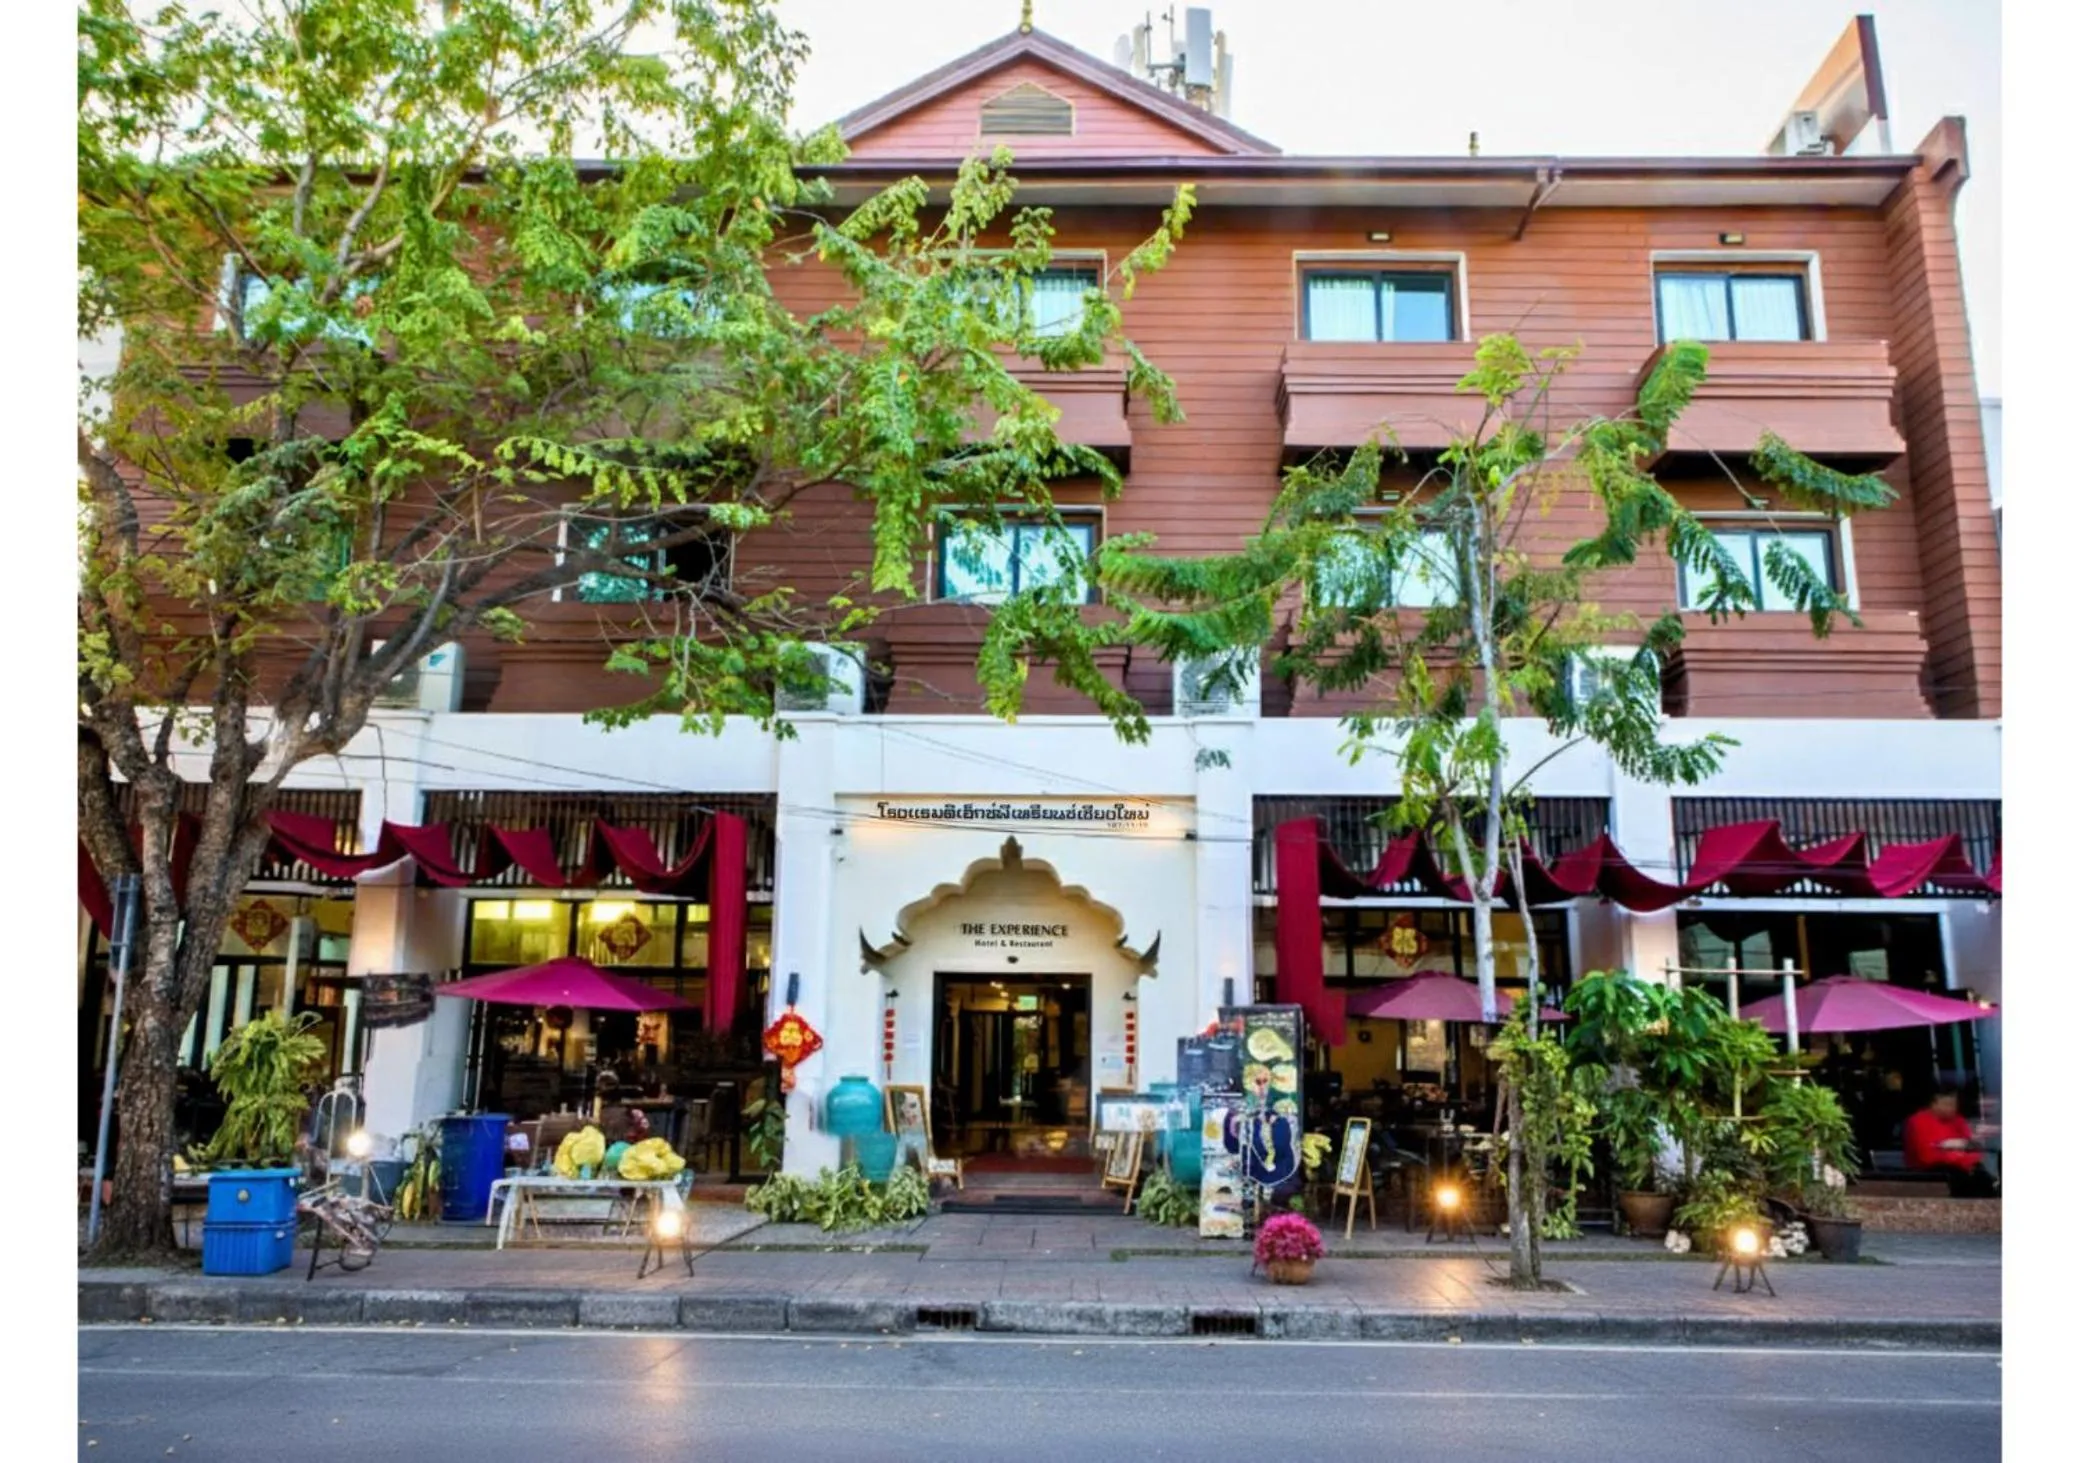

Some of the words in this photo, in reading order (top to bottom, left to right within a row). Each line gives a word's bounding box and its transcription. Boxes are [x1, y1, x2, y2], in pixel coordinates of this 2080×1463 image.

[961, 923, 985, 935] THE
[991, 924, 1069, 937] EXPERIENCE
[974, 939, 998, 947] Hotel
[1009, 940, 1053, 948] Restaurant
